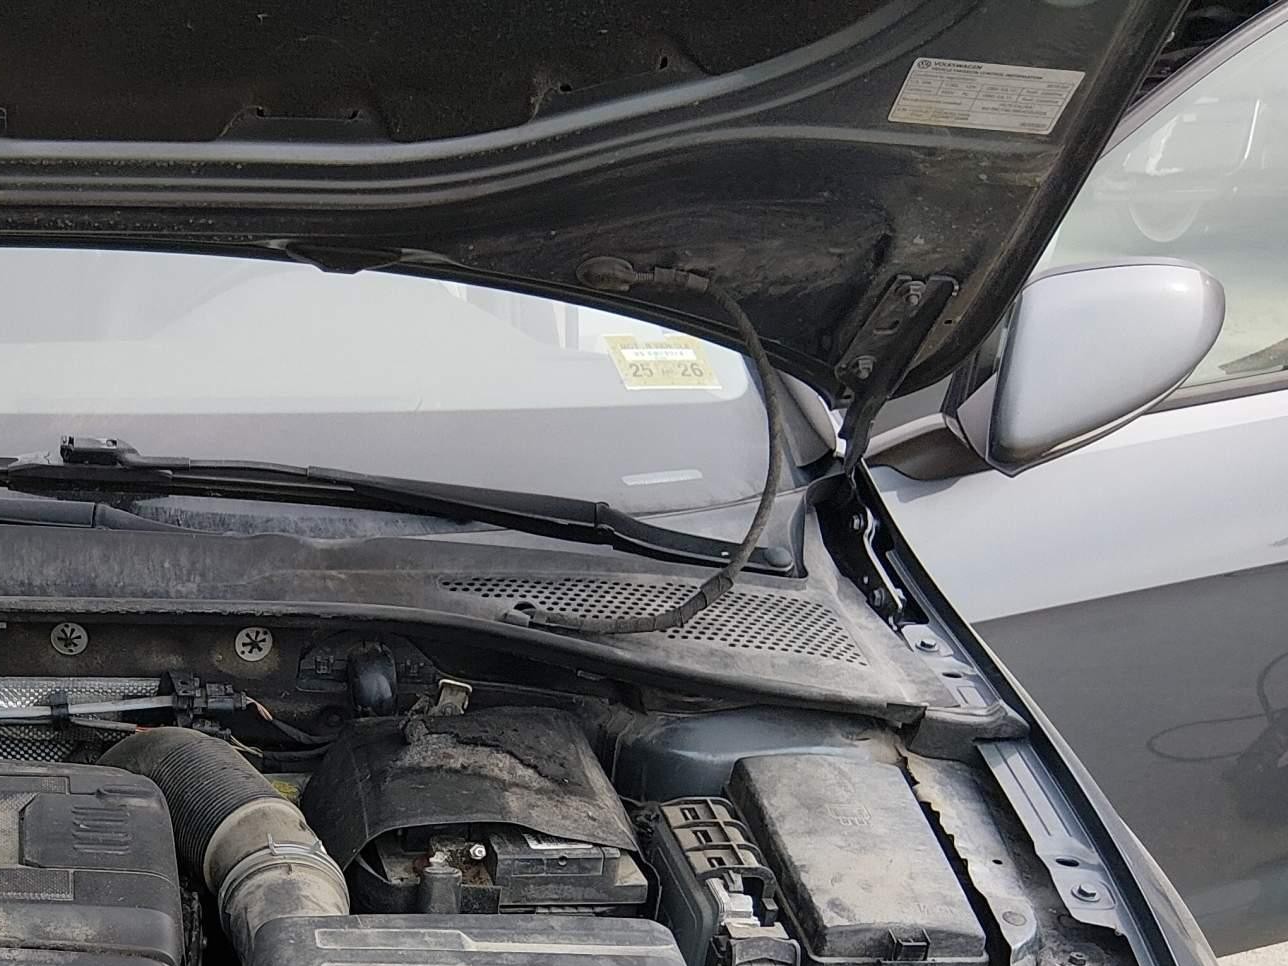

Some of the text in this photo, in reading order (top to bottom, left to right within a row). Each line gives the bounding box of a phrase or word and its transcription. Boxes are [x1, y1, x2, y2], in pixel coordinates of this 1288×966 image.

[933, 61, 983, 70] VOLKSWAGEN
[629, 363, 654, 377] 25
[678, 362, 704, 377] 26
